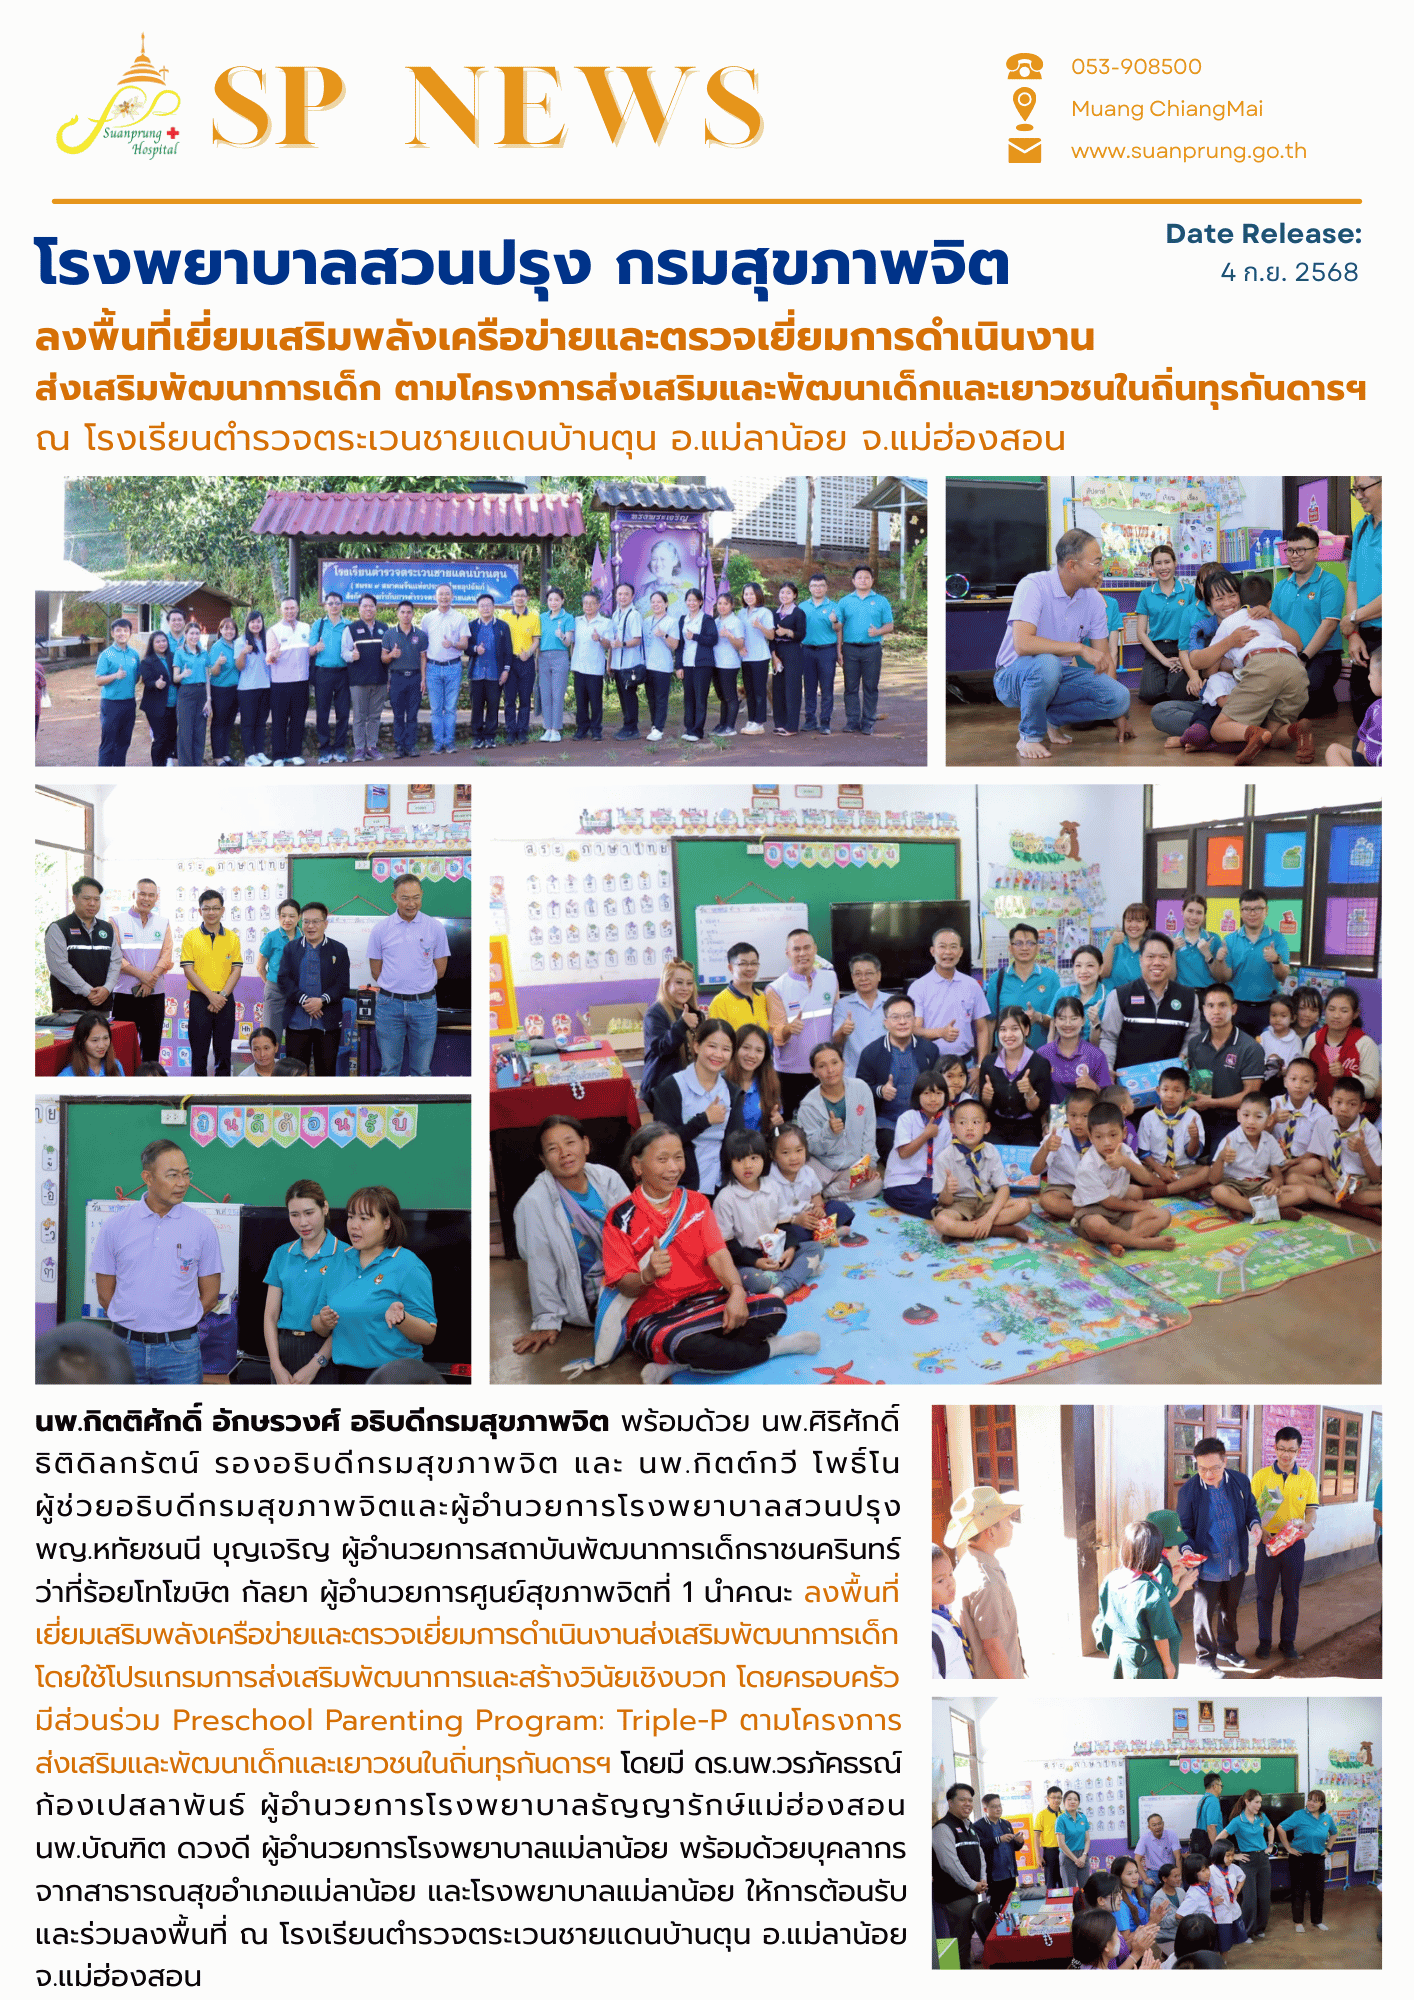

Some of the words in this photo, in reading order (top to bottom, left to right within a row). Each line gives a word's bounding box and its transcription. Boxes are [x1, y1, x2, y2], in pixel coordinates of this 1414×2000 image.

[196, 1112, 408, 1134] ยินดีต้อนรับ
